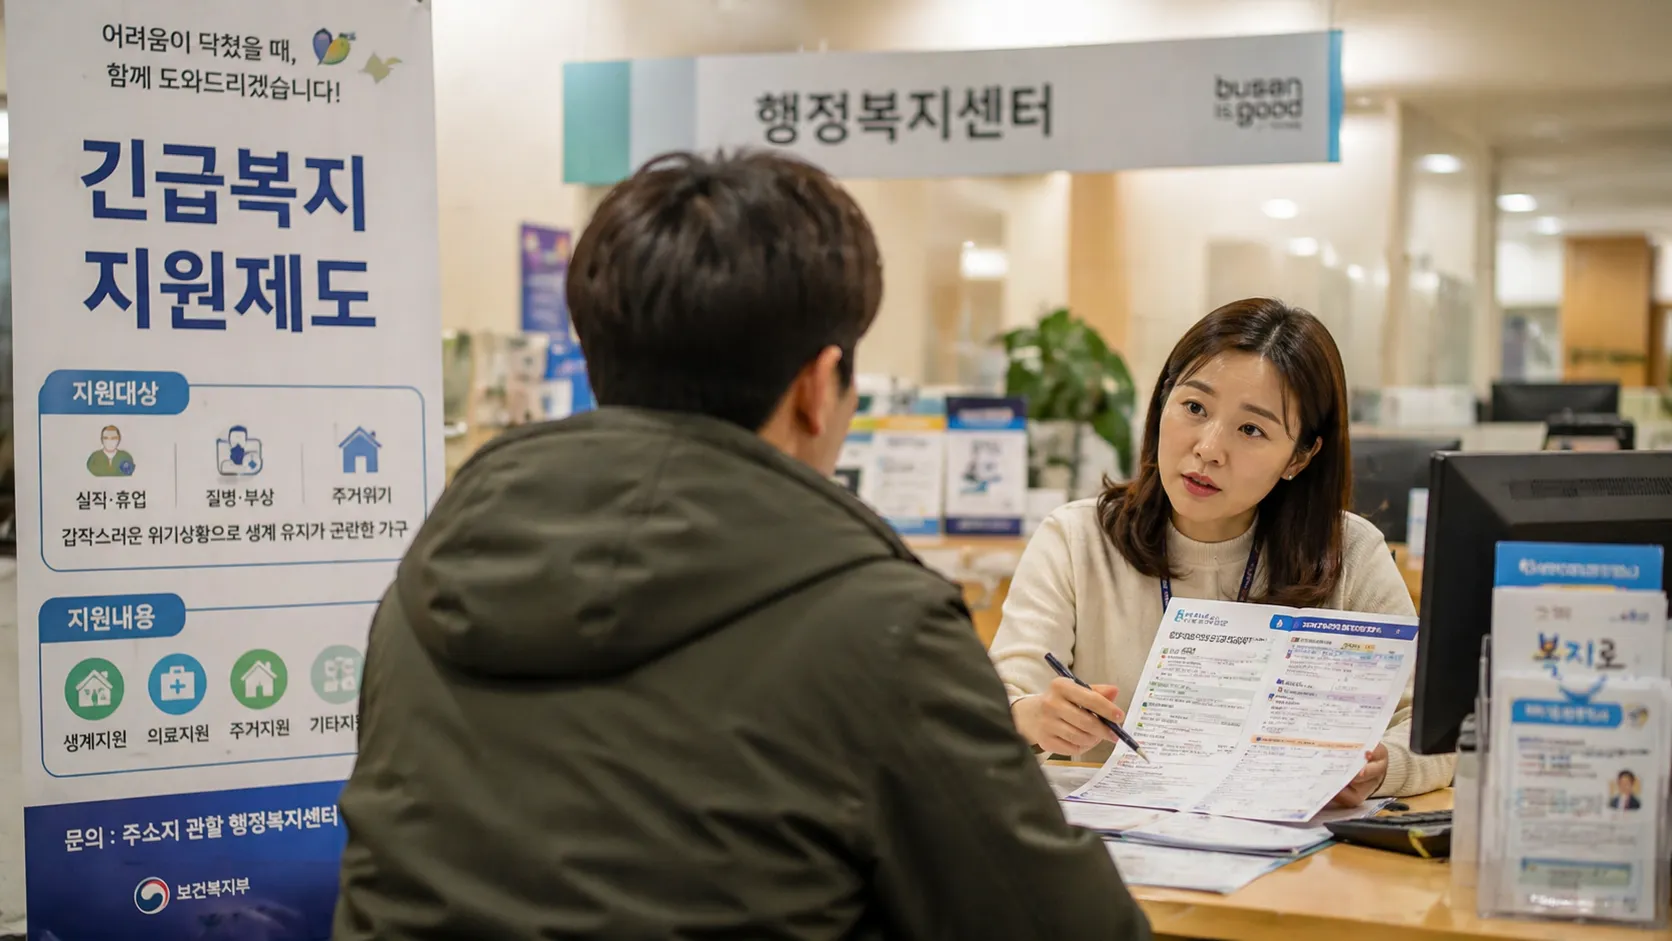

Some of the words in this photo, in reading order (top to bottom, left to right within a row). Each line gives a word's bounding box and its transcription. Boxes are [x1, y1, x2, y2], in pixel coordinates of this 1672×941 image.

[102, 24, 191, 54] 어려움이
[199, 32, 263, 61] 닥쳤을
[269, 38, 297, 65] 때,
[107, 62, 151, 90] 함께
[159, 68, 341, 103] 도와드리겠습니다!
[1214, 75, 1303, 101] busan
[755, 83, 1054, 146] 행정복지센터
[1236, 100, 1303, 128] good
[80, 139, 366, 231] 긴급복지
[83, 248, 376, 332] 지원제도
[72, 380, 158, 406] 지원대상
[76, 490, 146, 509] 실직·휴업
[206, 488, 274, 507] 질병·부상
[332, 486, 392, 505] 주거위기
[61, 526, 142, 547] 갑작스러운
[148, 524, 242, 545] 위기상황으로
[245, 523, 276, 542] 생계
[280, 522, 325, 541] 유지가
[379, 520, 408, 537] 가구
[67, 604, 155, 632] 지원내용
[1533, 631, 1626, 678] 복지로
[148, 724, 209, 745] 의료지원
[229, 719, 290, 740] 주거지원
[310, 714, 359, 734] 기타지
[63, 730, 127, 752] 생계지원
[65, 827, 104, 851] 문의
[122, 819, 180, 846] 주소지
[186, 815, 224, 840] 관할
[228, 804, 338, 835] 행정복지센터
[176, 877, 250, 901] 보건복지부
